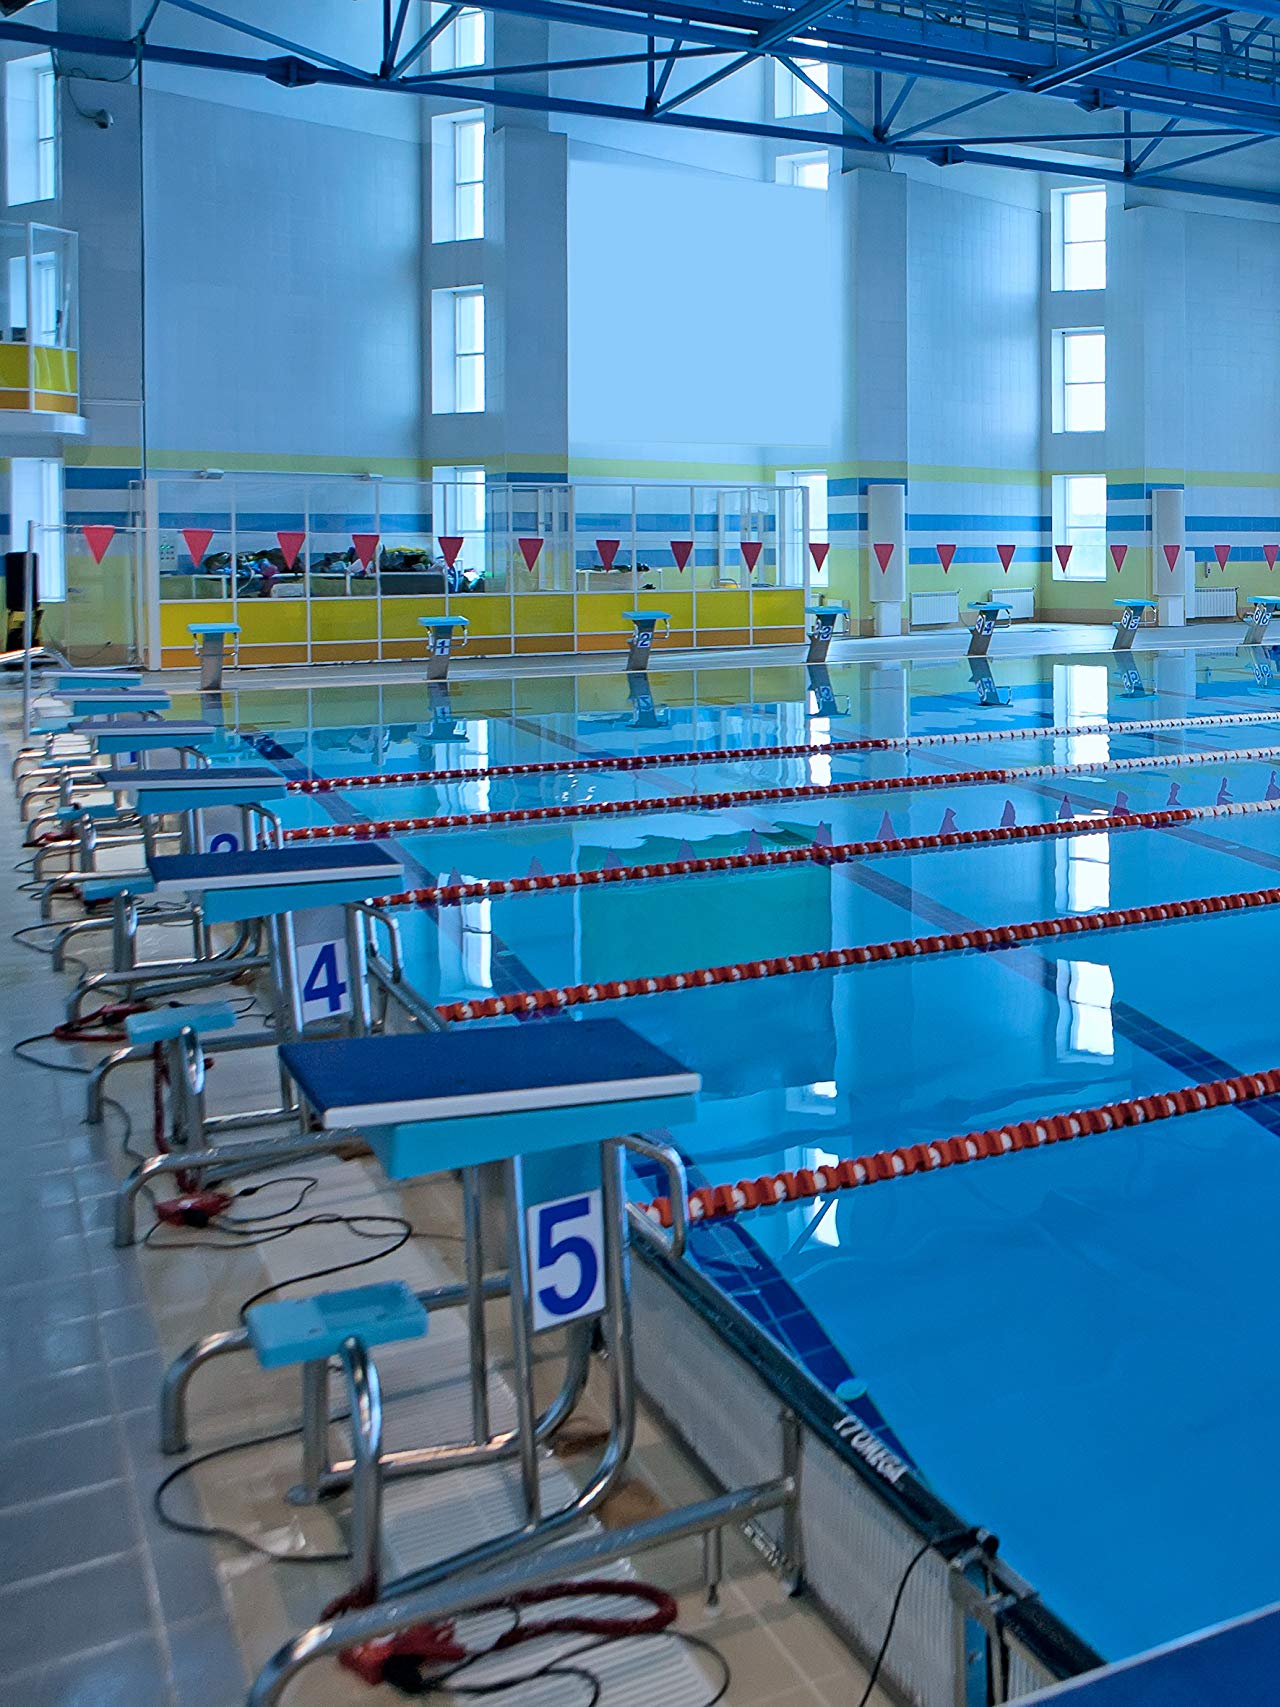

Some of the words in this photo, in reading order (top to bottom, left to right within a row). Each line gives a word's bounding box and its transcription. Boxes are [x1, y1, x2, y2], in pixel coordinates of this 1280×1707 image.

[1129, 616, 1139, 629] 5
[1261, 613, 1270, 625] 6
[984, 621, 993, 634] 4
[640, 633, 651, 647] 2
[438, 640, 446, 655] 1
[303, 942, 347, 1012] 4
[538, 1196, 598, 1316] 5
